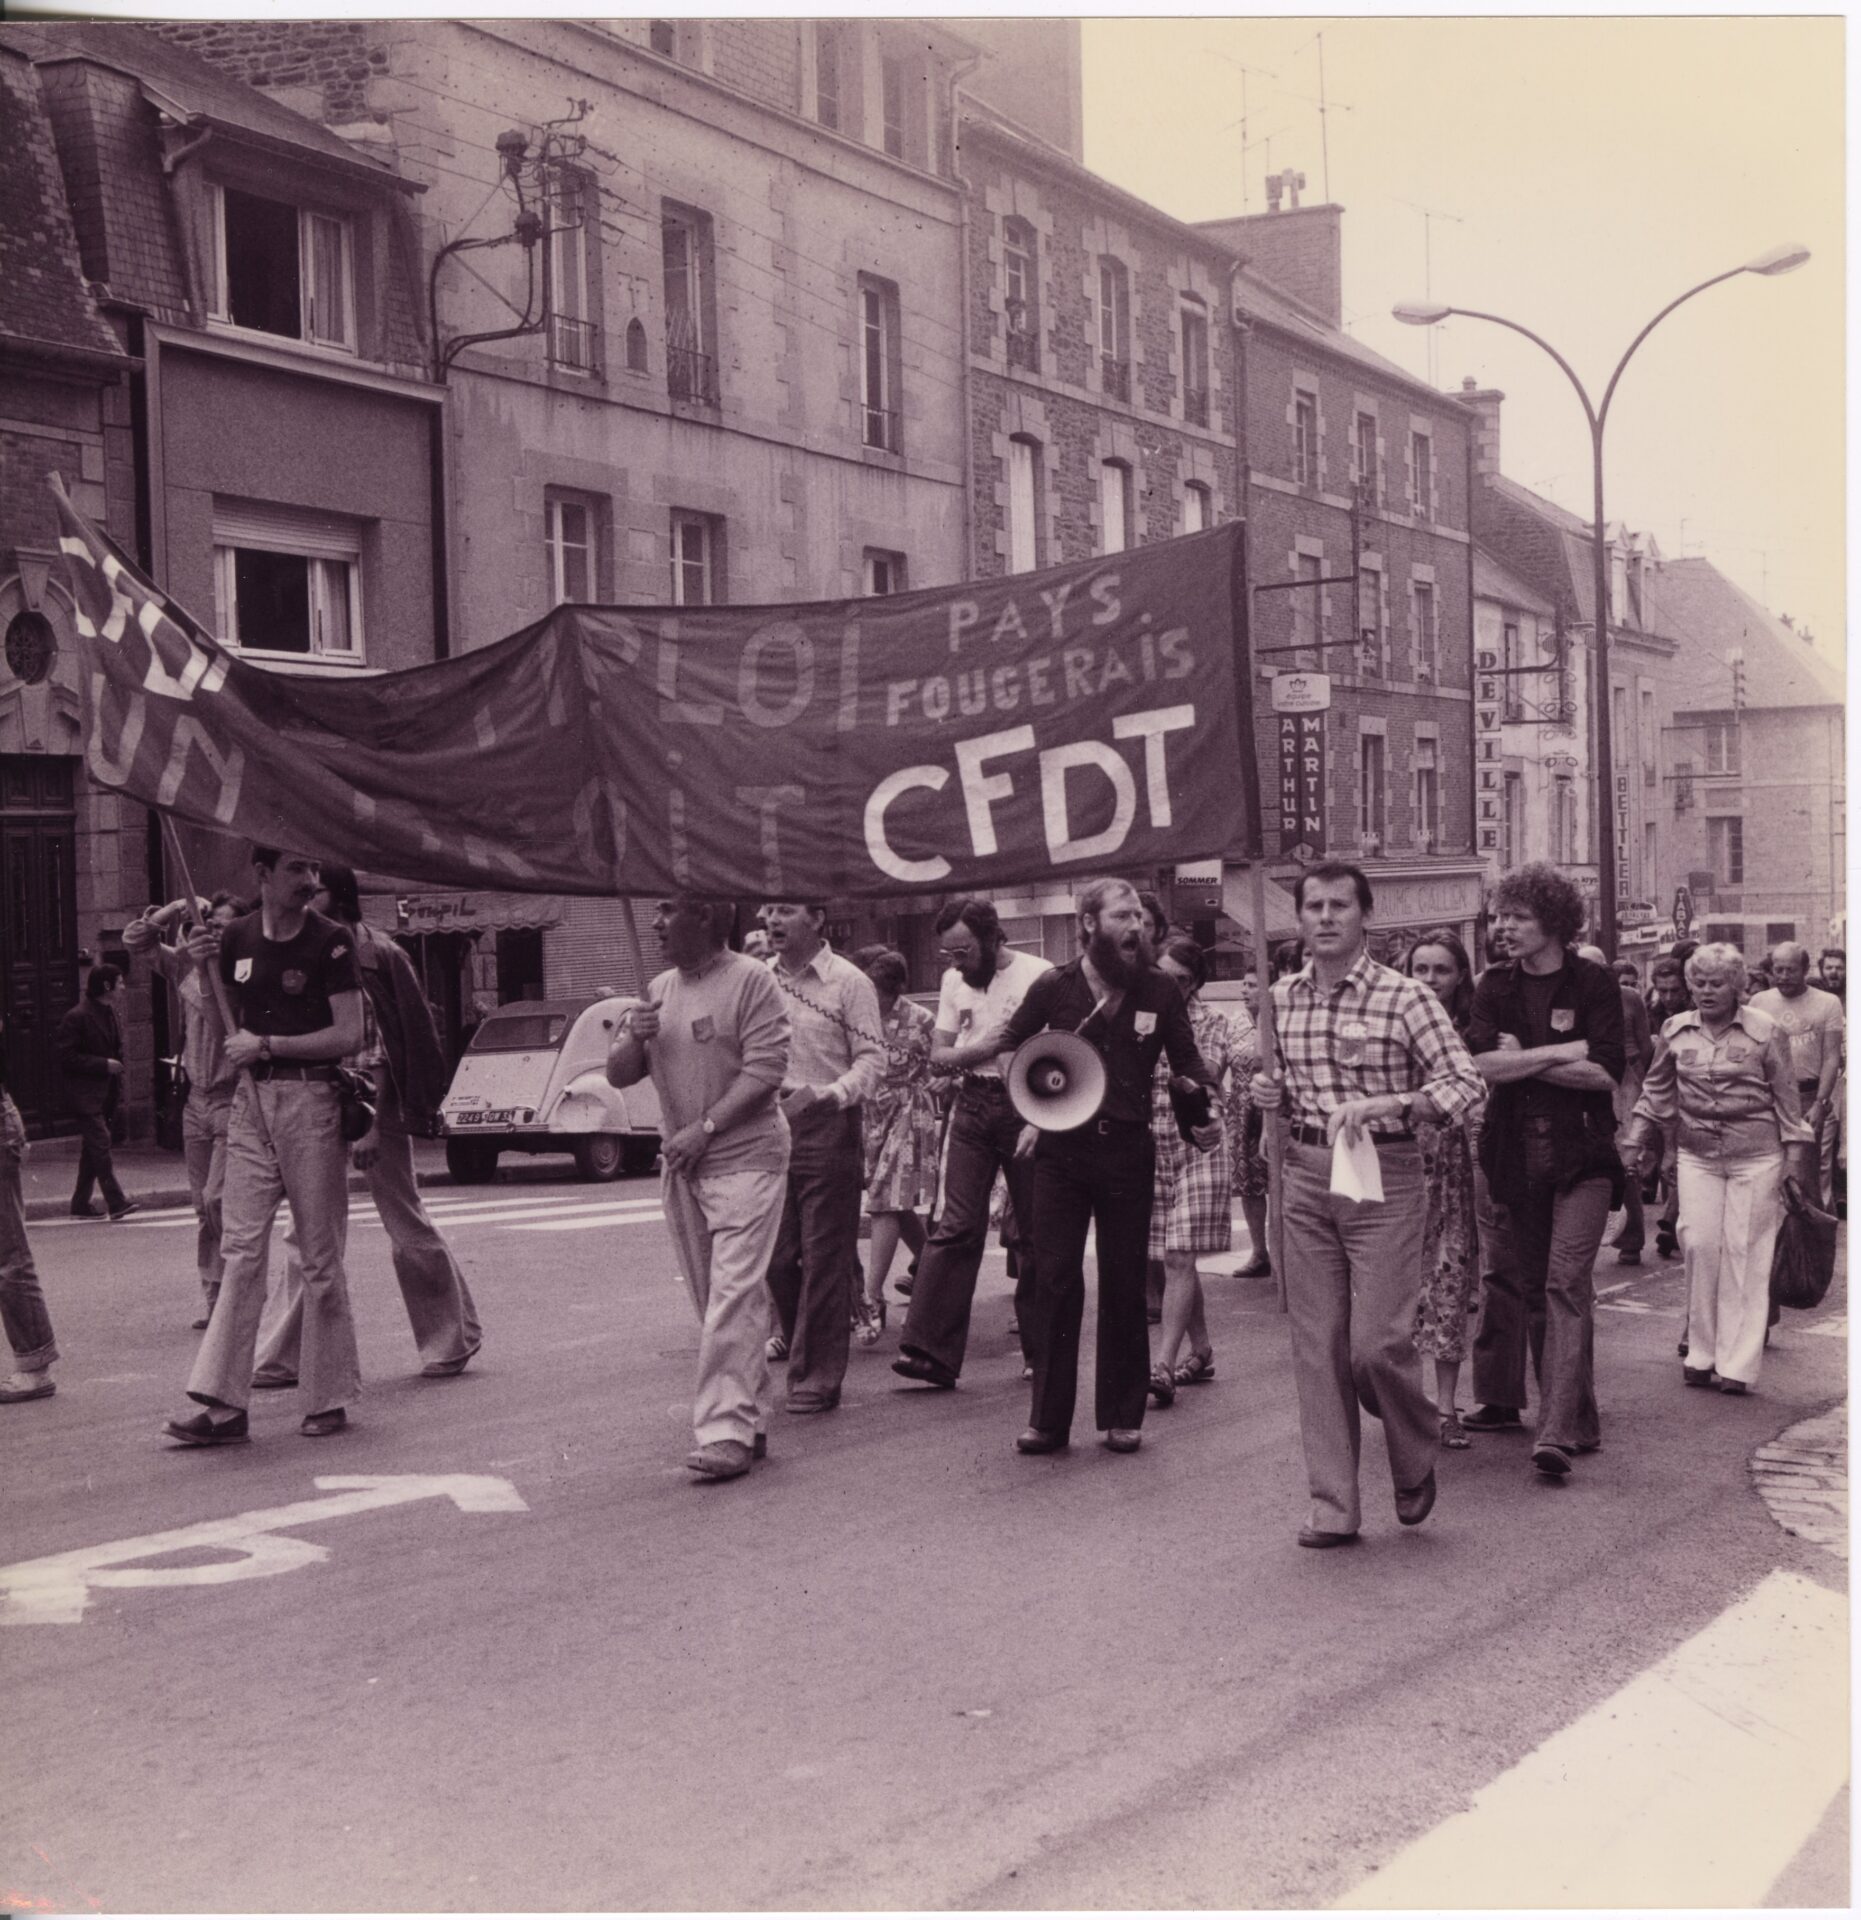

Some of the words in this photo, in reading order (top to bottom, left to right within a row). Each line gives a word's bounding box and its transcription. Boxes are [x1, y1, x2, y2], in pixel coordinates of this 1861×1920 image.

[949, 574, 1122, 652] PAYS
[87, 671, 246, 825] UN
[864, 704, 1197, 882] CFDT
[1281, 718, 1297, 831] ARTHUR
[1302, 717, 1321, 832] MARTIN
[1478, 651, 1497, 848] DEVILLE
[1177, 876, 1218, 884] SOMMER
[1676, 892, 1687, 938] TABAC
